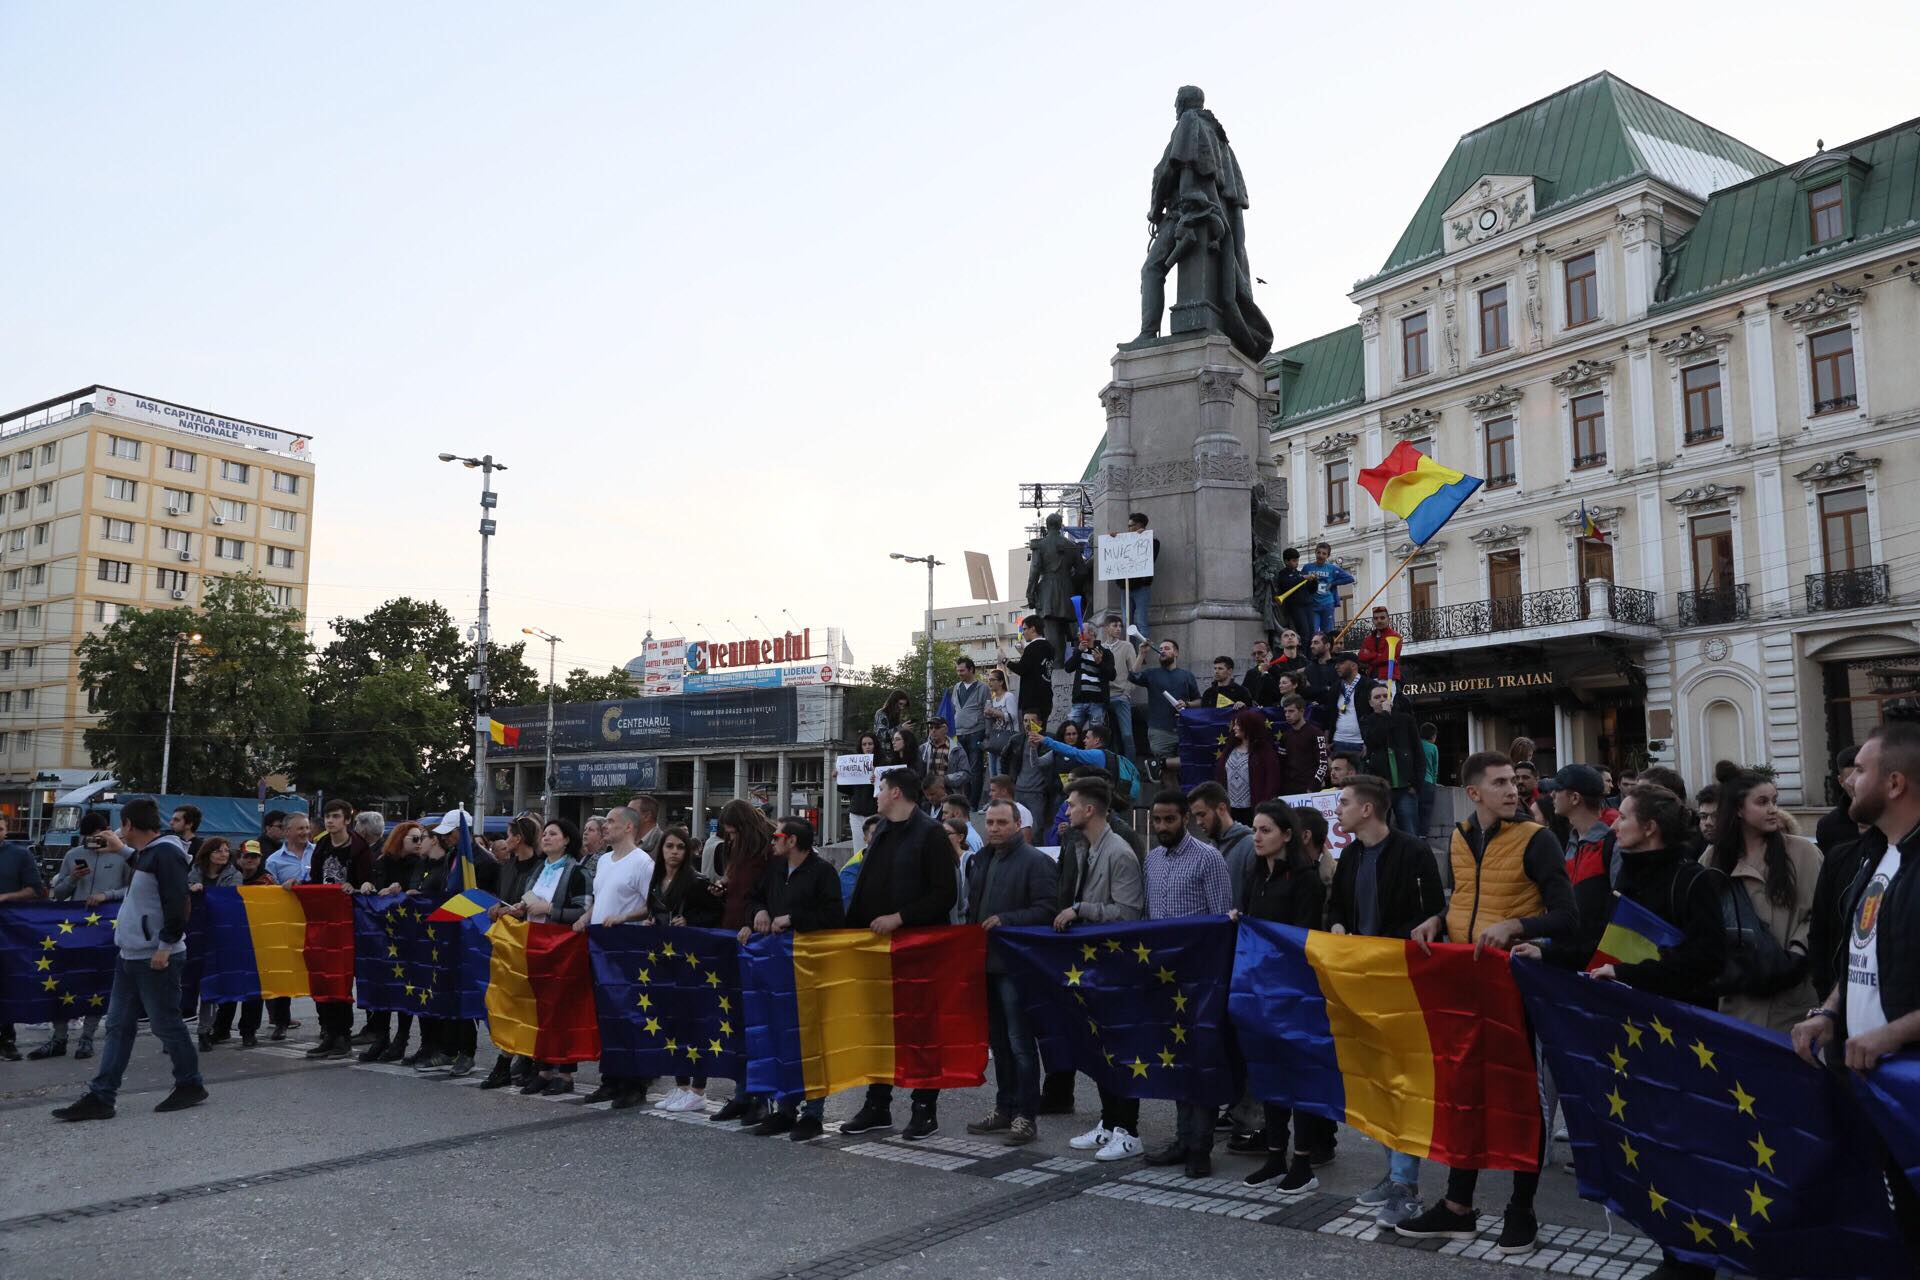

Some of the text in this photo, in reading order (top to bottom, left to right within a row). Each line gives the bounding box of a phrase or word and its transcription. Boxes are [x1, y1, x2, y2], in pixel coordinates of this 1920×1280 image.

[164, 407, 215, 426] CAPITALA
[218, 420, 278, 441] RENAȘTERII
[179, 419, 238, 439] NAȚIONALE
[1104, 544, 1132, 561] MUIE
[783, 666, 817, 676] LIDERUL
[1402, 672, 1553, 695] GRAND HOTEL TRAIAN
[617, 716, 671, 728] CENTENARUL
[591, 773, 608, 787] HORA
